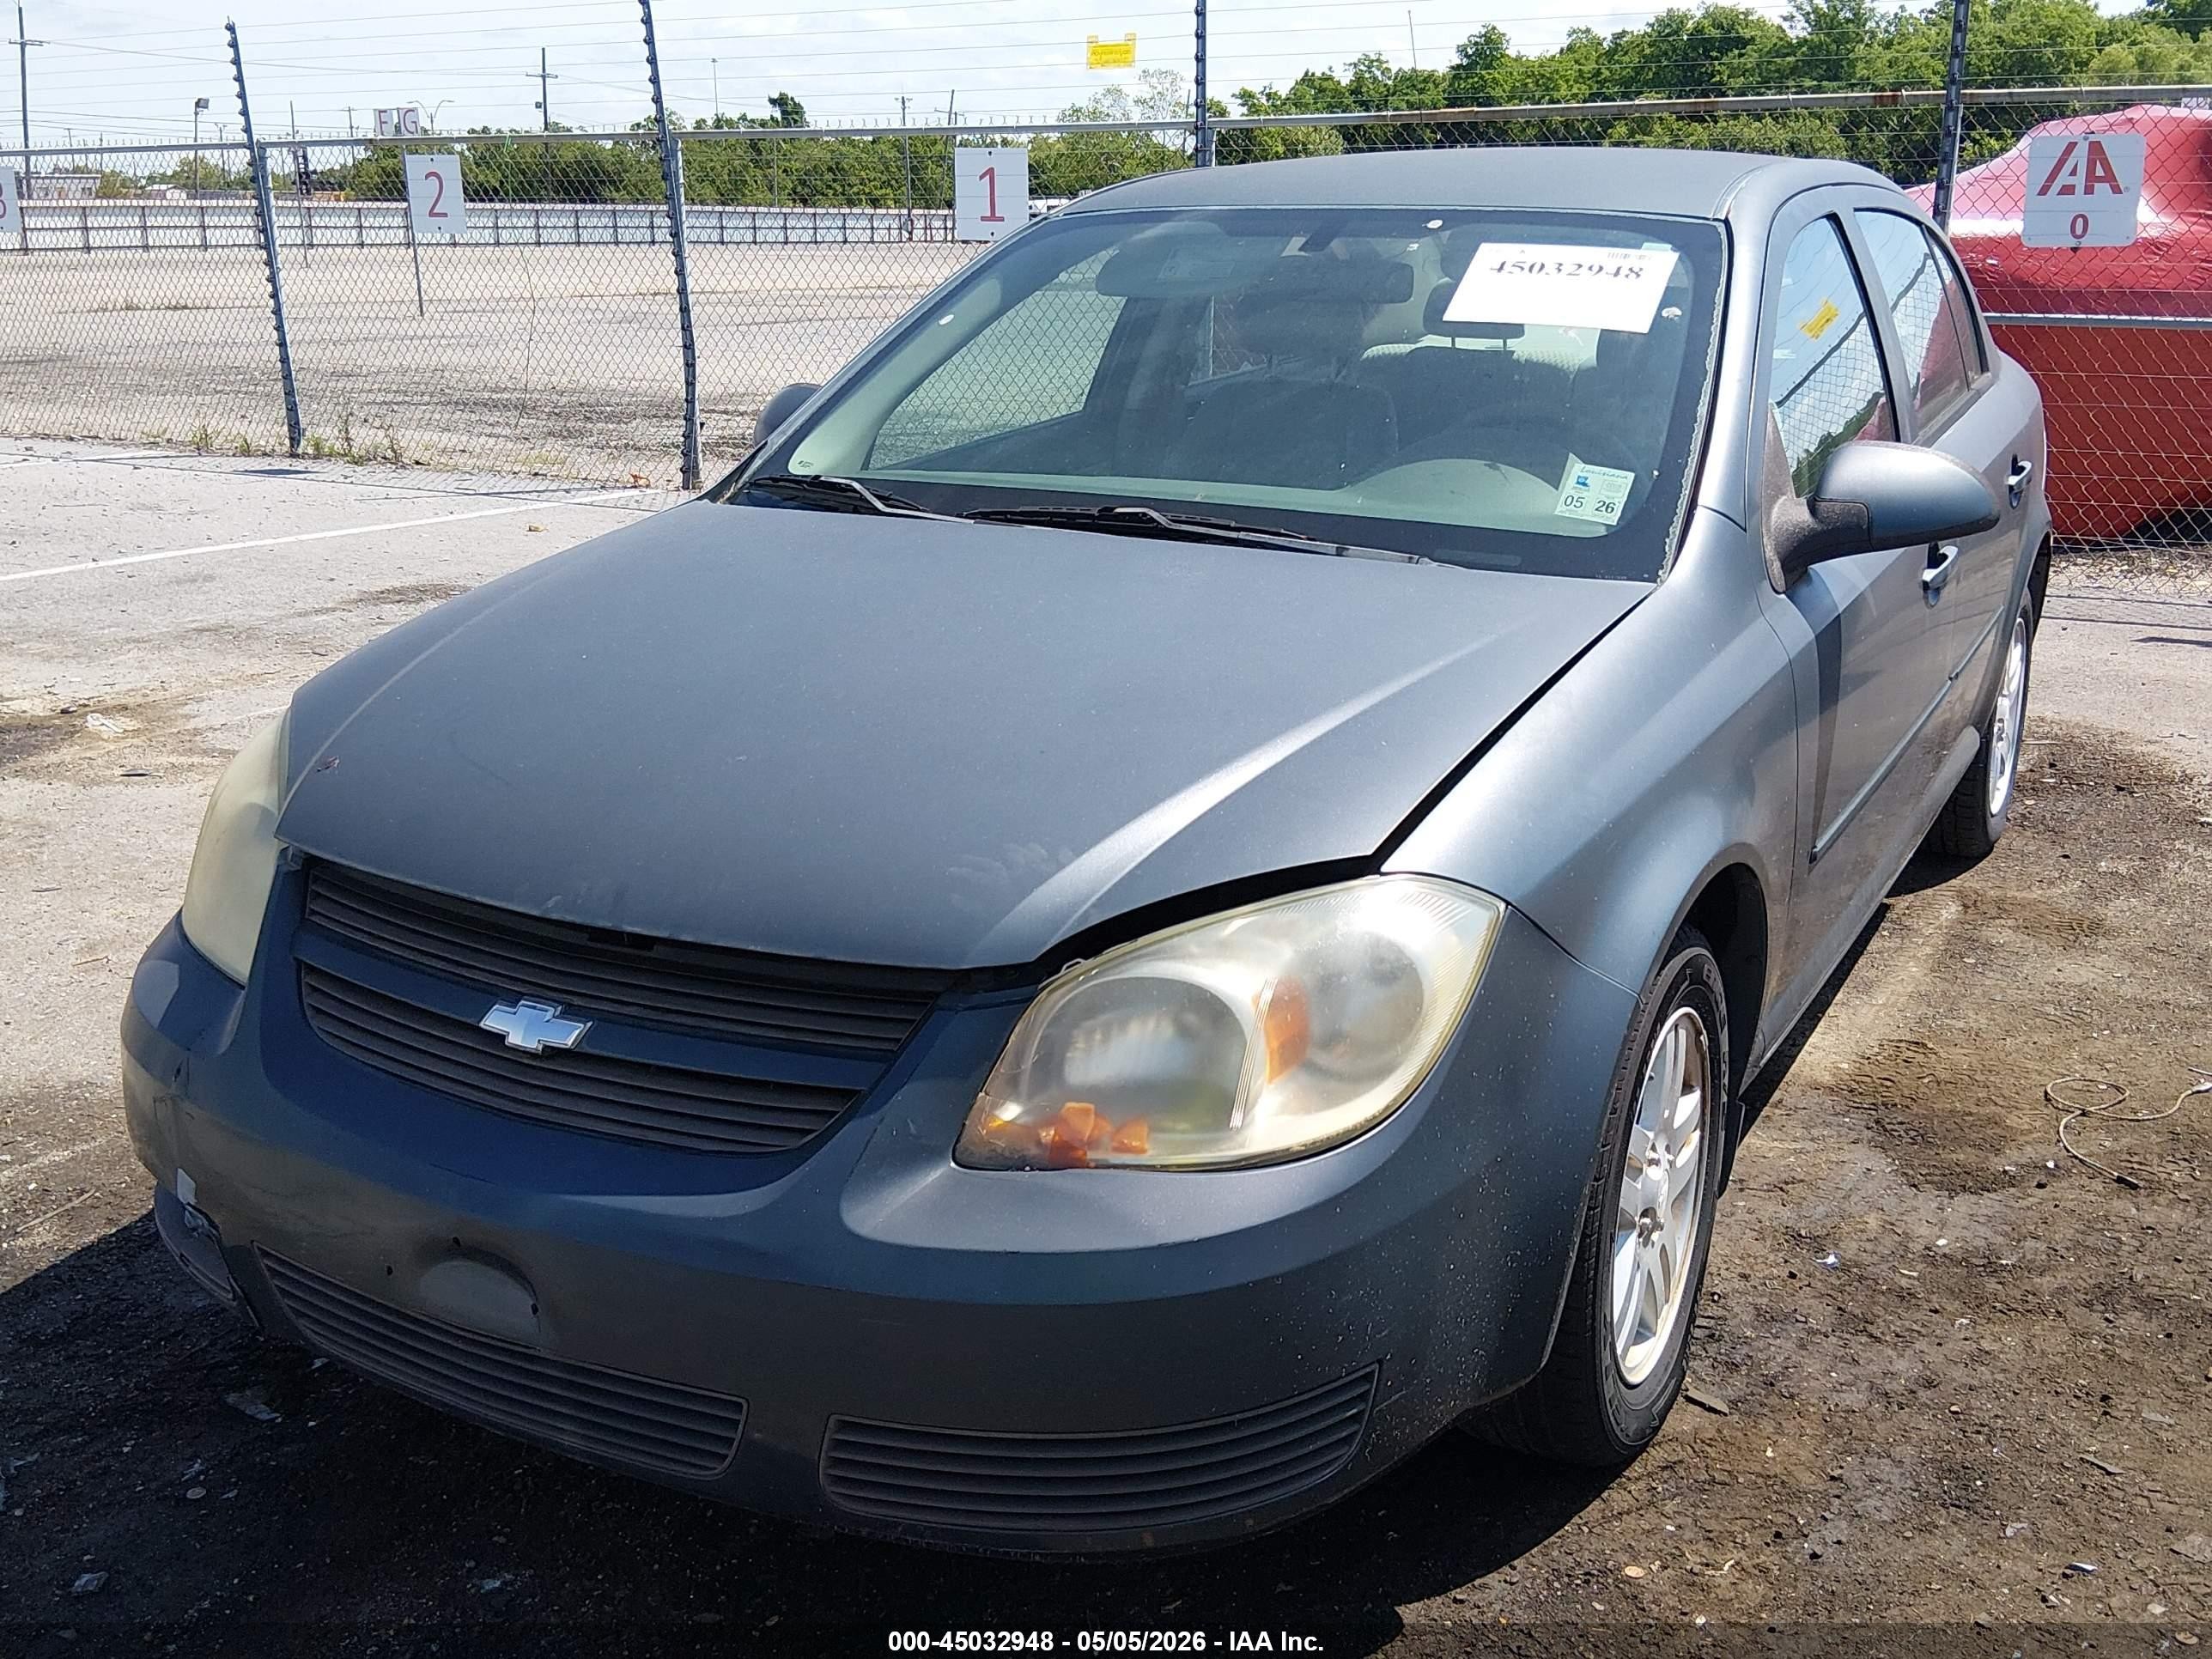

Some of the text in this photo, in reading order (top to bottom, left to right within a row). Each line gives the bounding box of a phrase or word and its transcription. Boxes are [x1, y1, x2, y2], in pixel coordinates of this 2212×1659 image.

[403, 109, 418, 134] G
[424, 171, 448, 218] 2
[979, 167, 1005, 222] 1
[2069, 213, 2089, 240] 0
[1490, 260, 1644, 279] 45032948
[1564, 495, 1615, 514] 05 26
